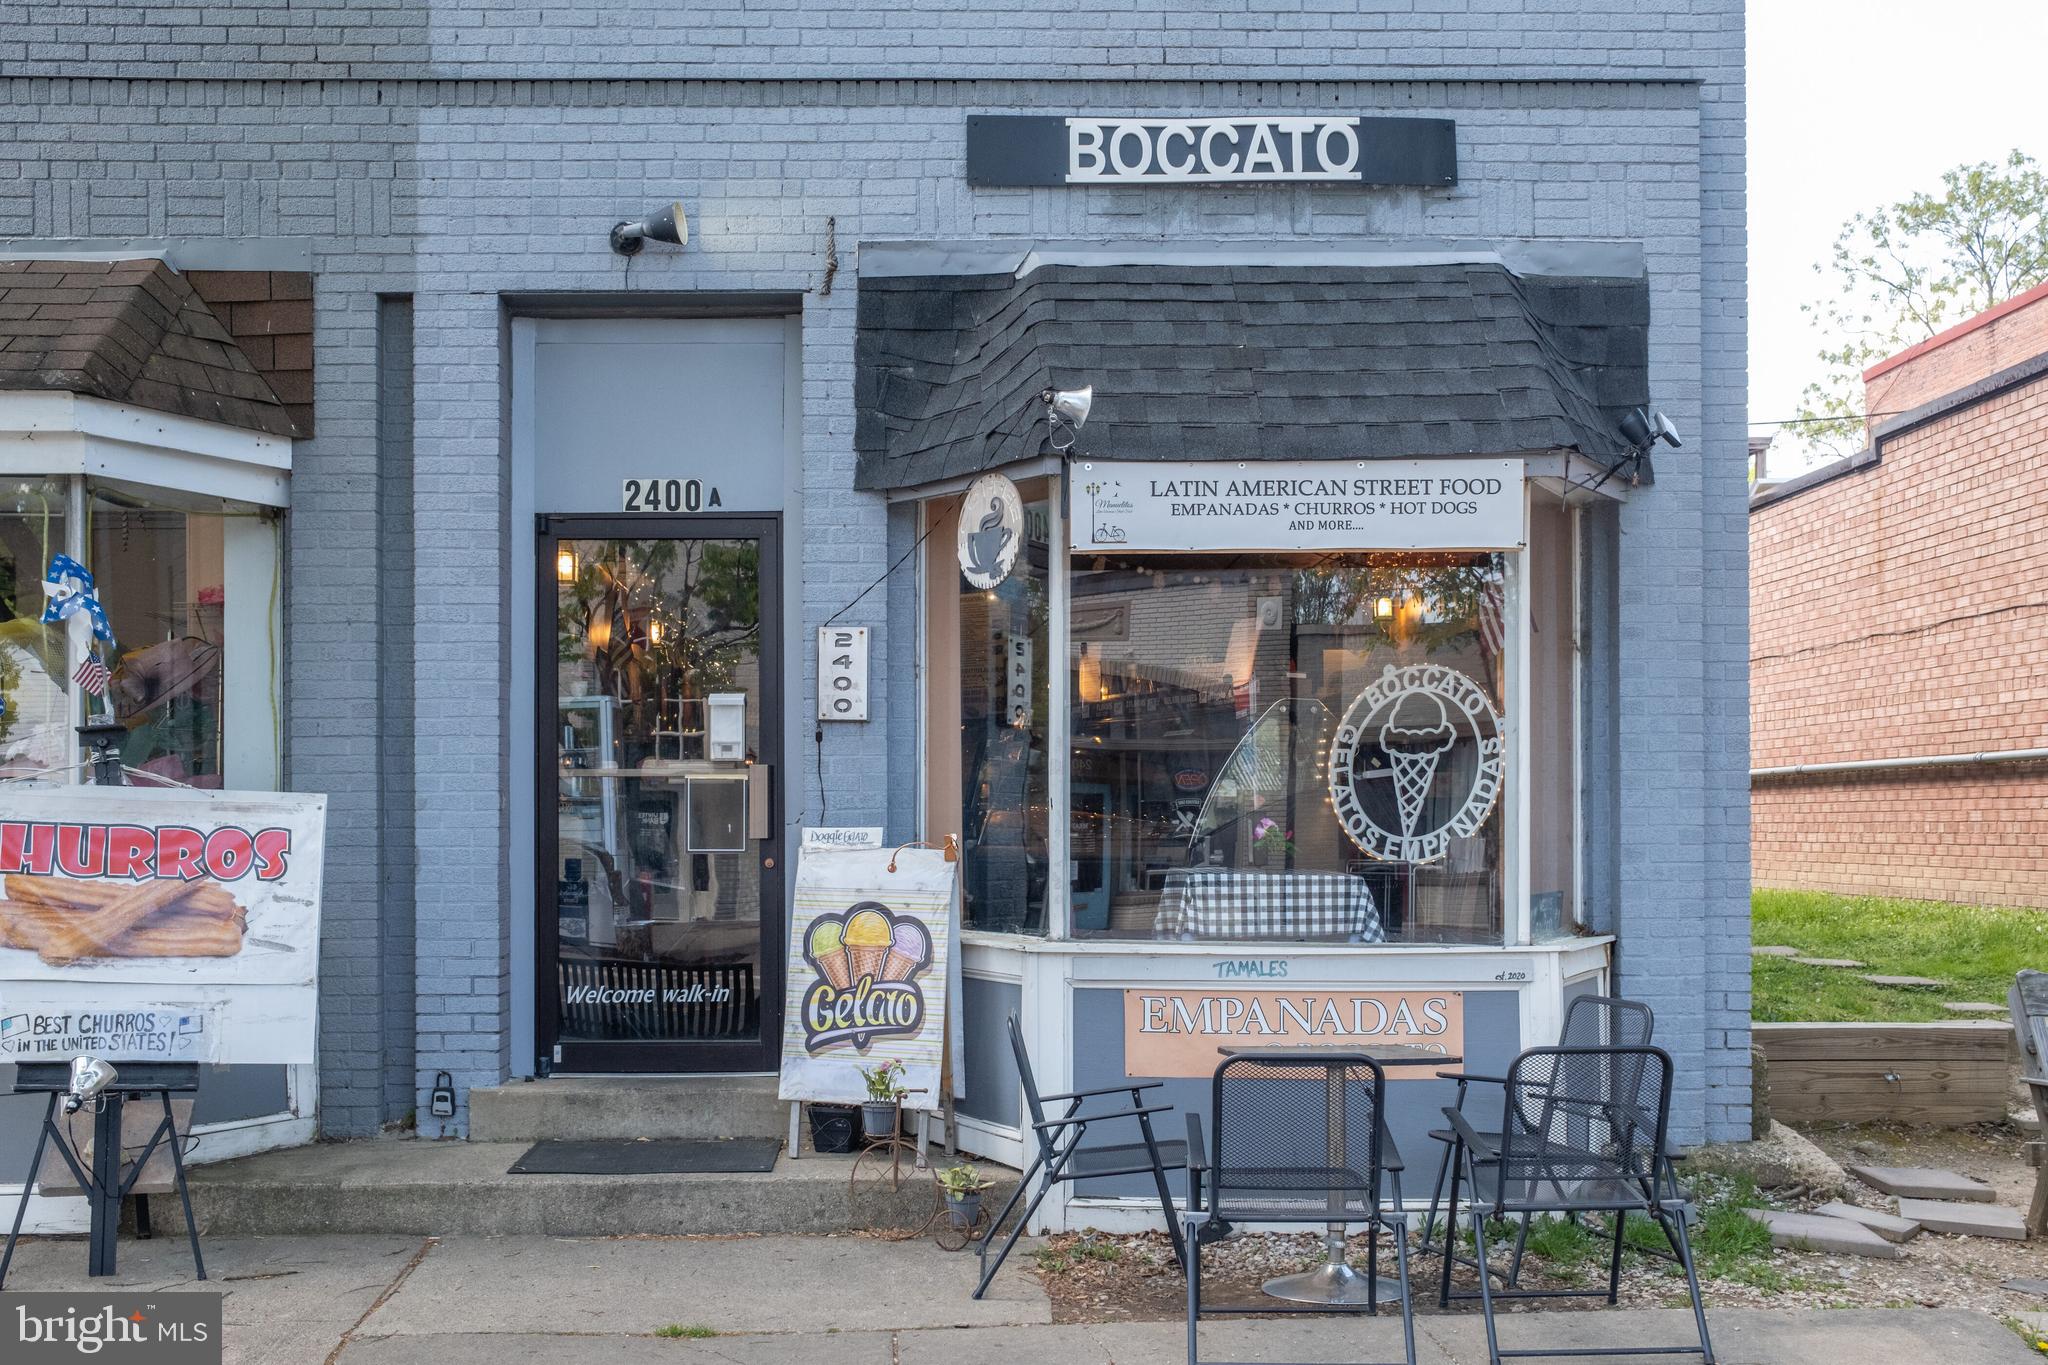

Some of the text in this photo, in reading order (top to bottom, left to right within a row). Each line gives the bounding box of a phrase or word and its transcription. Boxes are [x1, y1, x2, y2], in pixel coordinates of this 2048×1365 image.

[1069, 122, 1360, 176] BOCCATO
[624, 479, 722, 512] 2400 A
[1150, 478, 1502, 498] LATIN AMERICAN STREET FOOD
[1171, 501, 1478, 517] EMPANADAS CHURROS HOT DOGS
[1288, 520, 1315, 531] AND
[833, 632, 853, 713] 2400
[1364, 668, 1485, 714] BOCCATO
[1334, 725, 1380, 850] GELATOS
[1383, 737, 1500, 861] EMPANADAS
[1212, 960, 1288, 978] TAMALES
[567, 983, 730, 1004] Welcome walk-in
[808, 975, 918, 1032] Gelato
[33, 1013, 157, 1035] BEST CHURROS
[1139, 996, 1448, 1036] EMPANADAS
[34, 1039, 57, 1052] THE
[108, 1032, 177, 1056] STATES!
